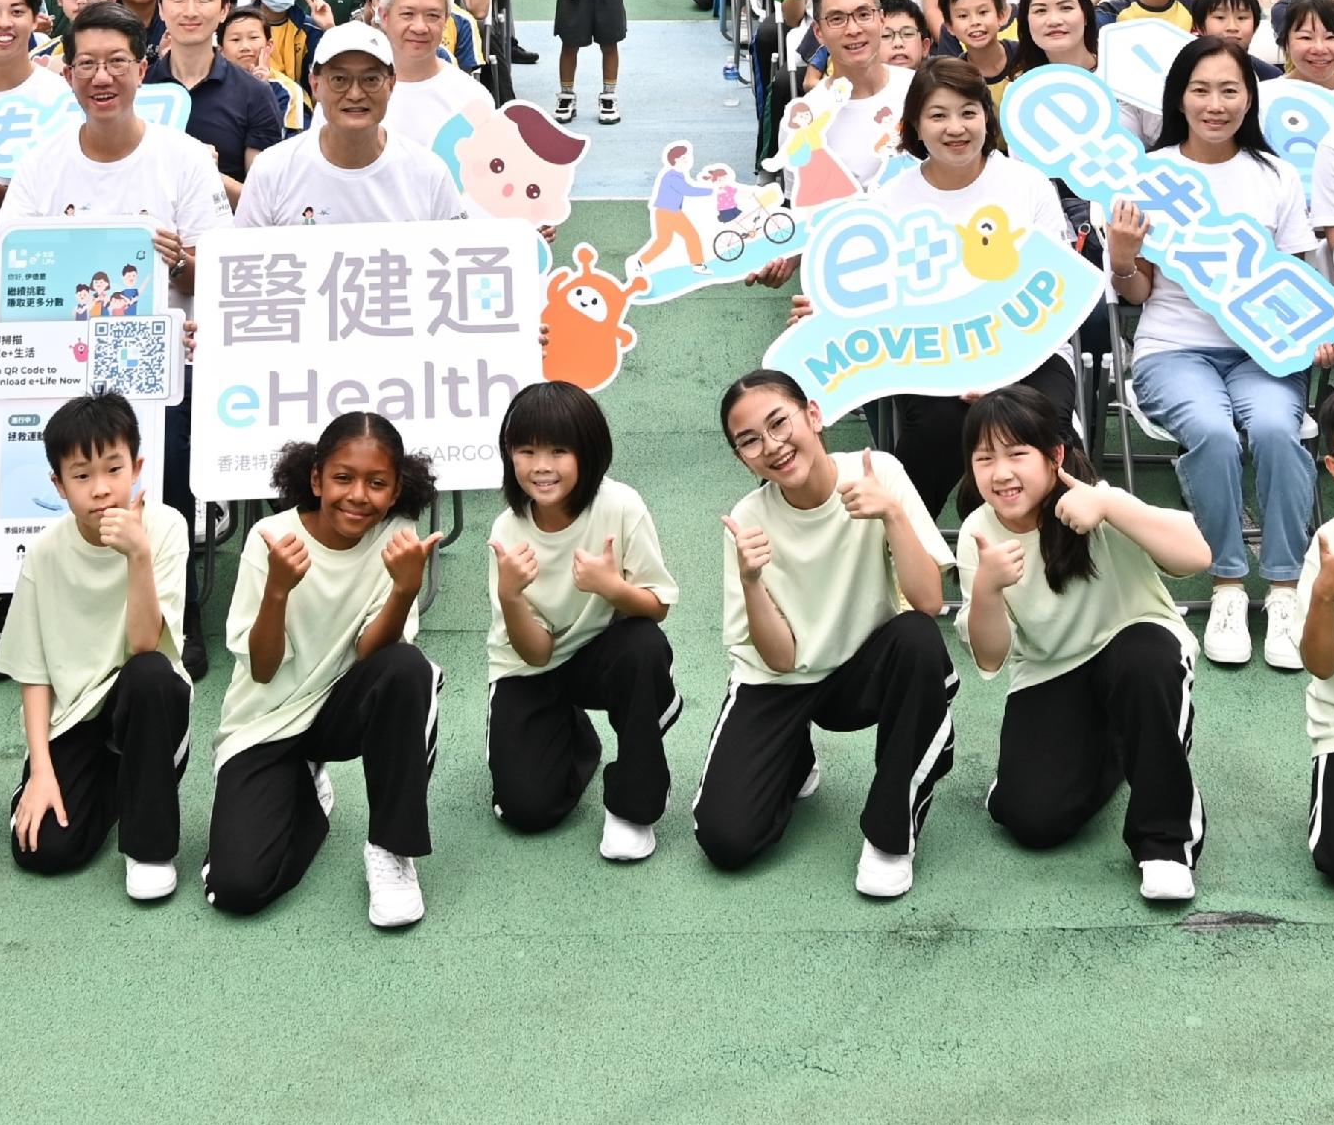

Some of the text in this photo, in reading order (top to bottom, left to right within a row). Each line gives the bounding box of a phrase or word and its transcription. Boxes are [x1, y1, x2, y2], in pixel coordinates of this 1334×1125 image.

[218, 247, 520, 346] 醫健通
[804, 270, 1056, 387] MOVE IT UP
[4, 366, 18, 376] QR
[20, 366, 45, 375] Code
[47, 366, 57, 374] to
[28, 377, 57, 385] e+Life
[59, 377, 81, 385] Now
[217, 358, 519, 428] eHealth
